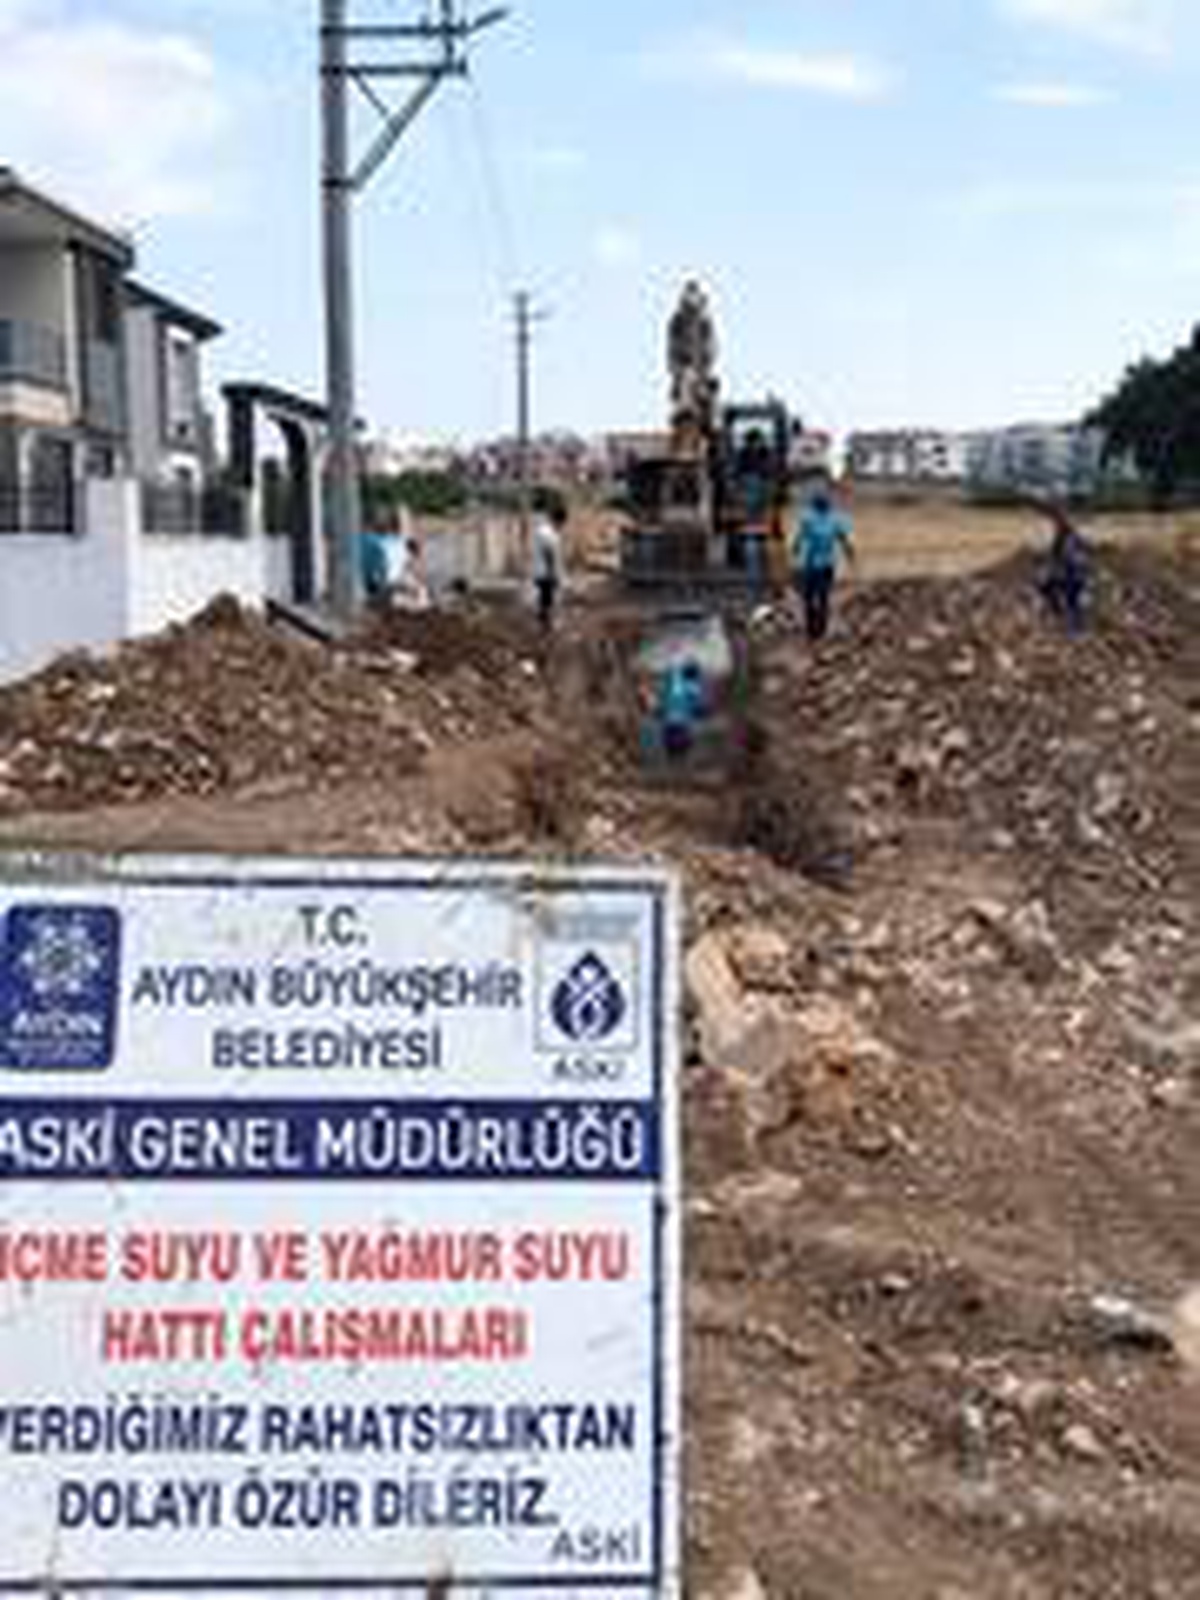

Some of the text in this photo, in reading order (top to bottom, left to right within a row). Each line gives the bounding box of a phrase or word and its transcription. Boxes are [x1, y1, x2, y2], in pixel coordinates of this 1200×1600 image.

[297, 904, 367, 946] T.C.
[132, 957, 523, 1015] AYDIN BÜYÜKŞEHİR
[211, 1023, 442, 1070] BELEDİYESİ
[129, 1117, 304, 1169] GENEL
[316, 1106, 644, 1170] MÜDÜRLÜĞÜ
[119, 1232, 241, 1282] SUYU
[254, 1232, 308, 1282] VE
[320, 1219, 502, 1282] YAĞMUR
[512, 1232, 629, 1282] SUYU
[103, 1309, 528, 1378] HATTI ÇALIŞMALARI
[261, 1404, 635, 1452] RAHATSIZLIKTAN
[58, 1480, 223, 1529] DOLAYI
[236, 1464, 362, 1529] ÖZÜR
